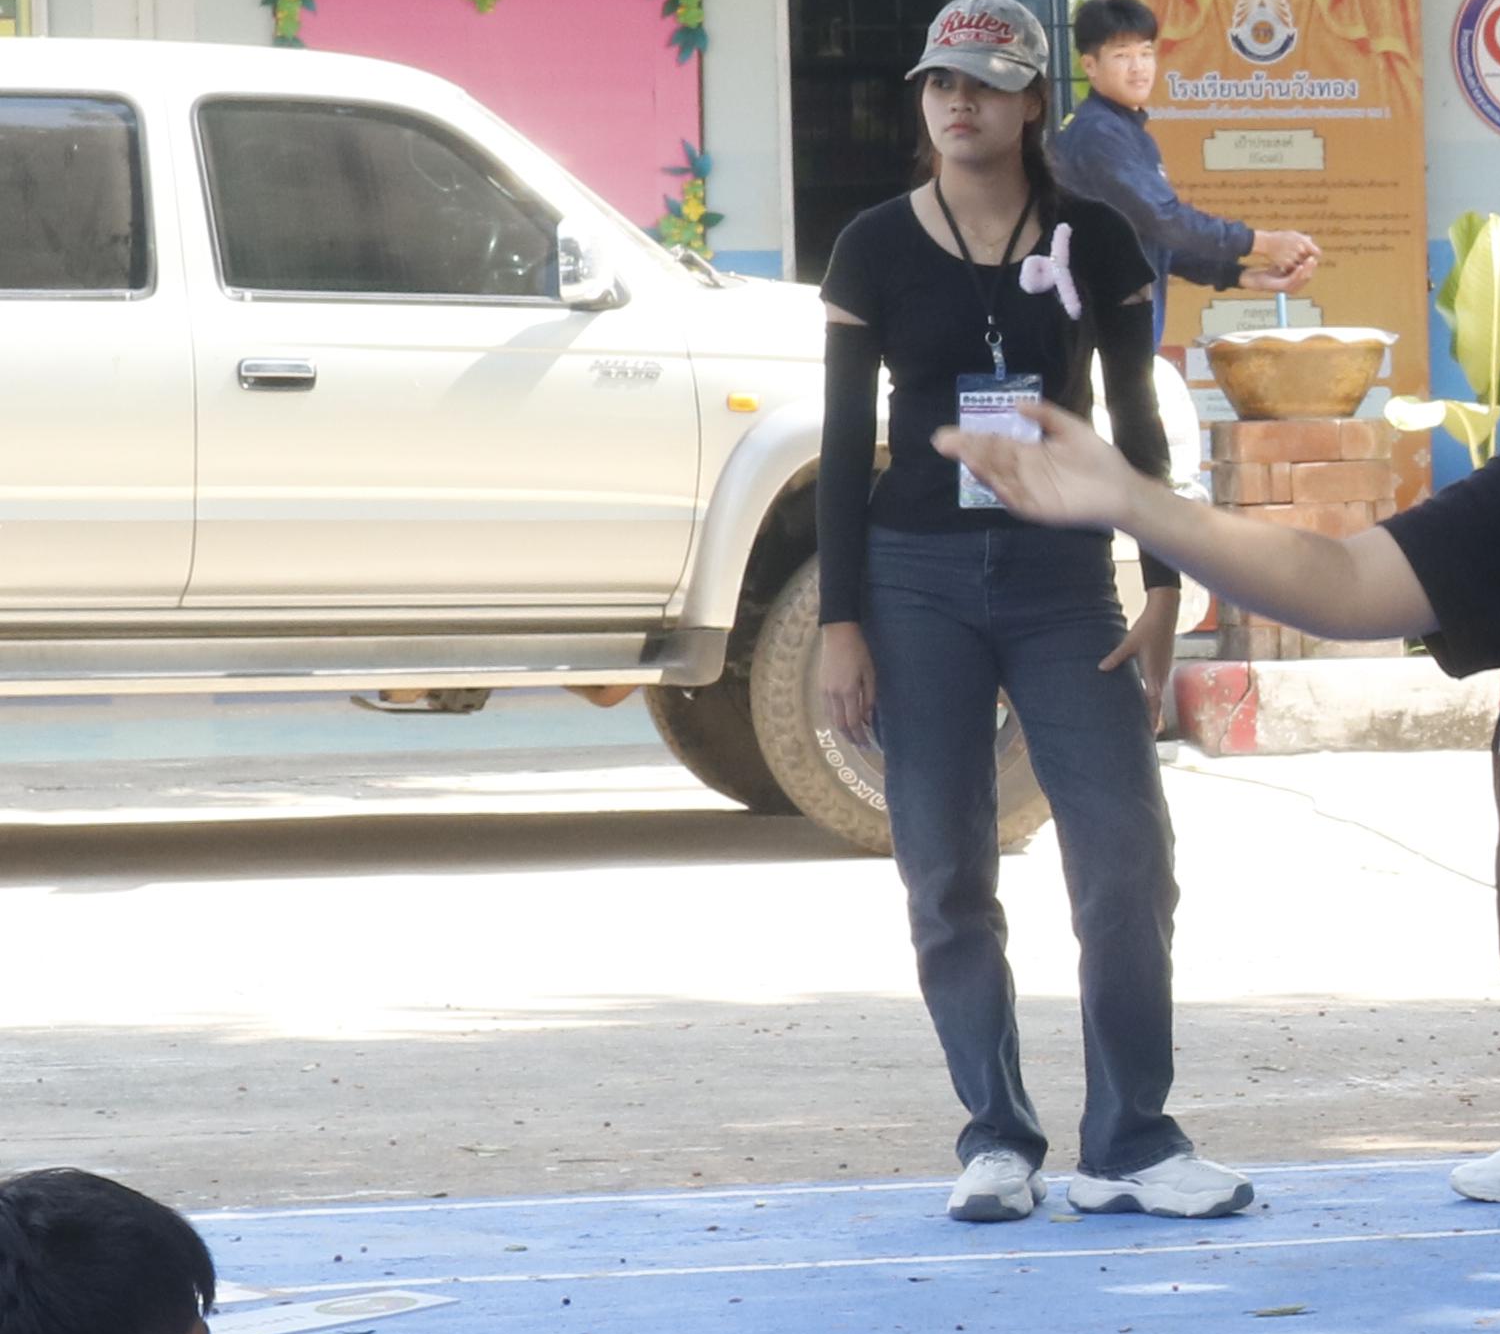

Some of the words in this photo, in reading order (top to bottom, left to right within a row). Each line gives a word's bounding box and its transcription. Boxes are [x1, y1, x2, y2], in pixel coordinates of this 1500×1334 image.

[1165, 69, 1360, 100] โรงเรียนบ้านวังทอง
